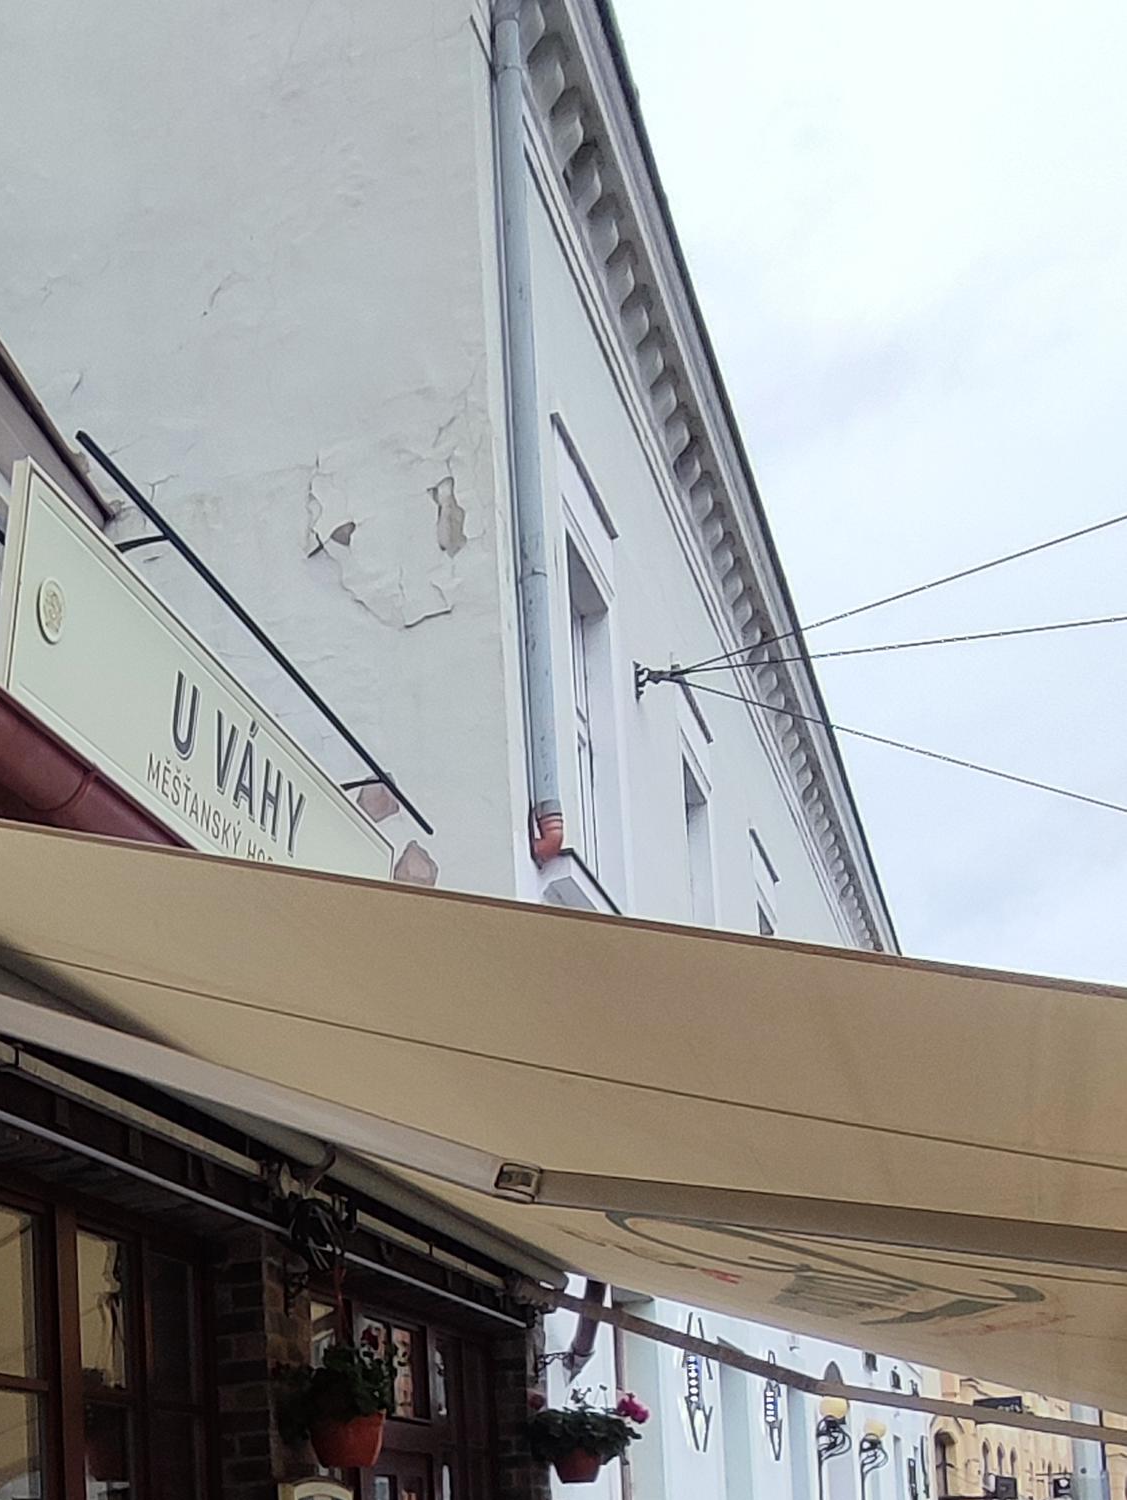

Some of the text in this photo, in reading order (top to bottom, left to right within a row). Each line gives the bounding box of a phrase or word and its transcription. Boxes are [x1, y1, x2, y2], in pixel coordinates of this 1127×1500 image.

[147, 752, 242, 854] MĚŠŤANSKÝ
[172, 669, 306, 858] U VÁHY
